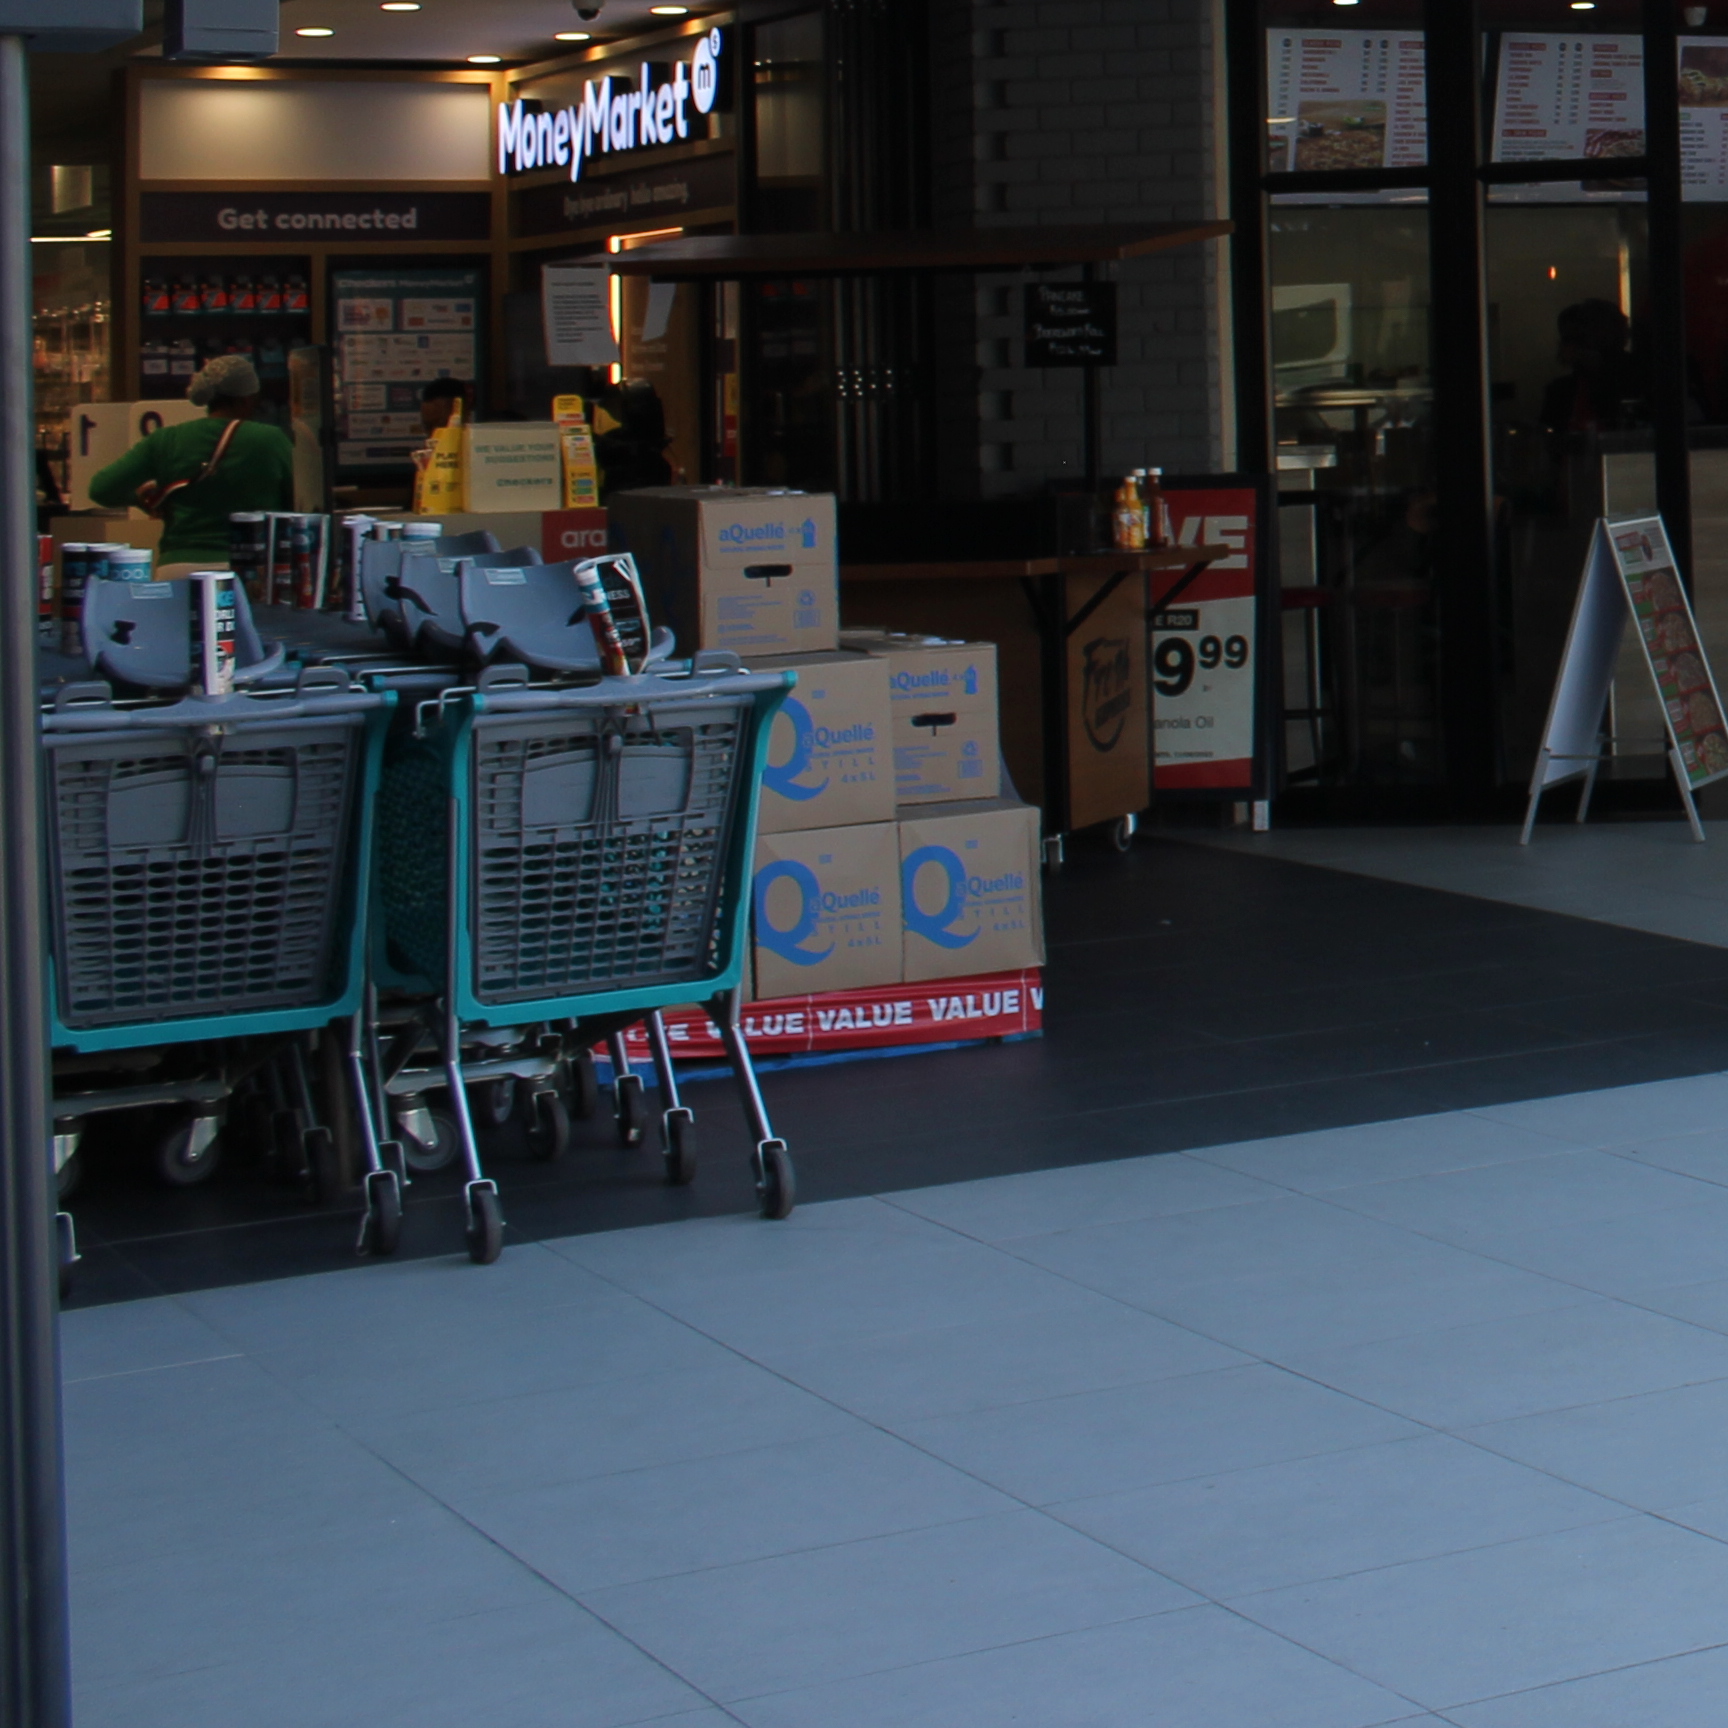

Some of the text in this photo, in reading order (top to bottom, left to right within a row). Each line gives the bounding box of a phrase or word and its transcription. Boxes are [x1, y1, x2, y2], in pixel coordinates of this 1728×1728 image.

[498, 60, 690, 183] MoneyMarket
[217, 207, 418, 231] Get connected
[1153, 714, 1191, 729] anola
[816, 1000, 913, 1033] VALUE
[926, 987, 1021, 1023] VALUE
